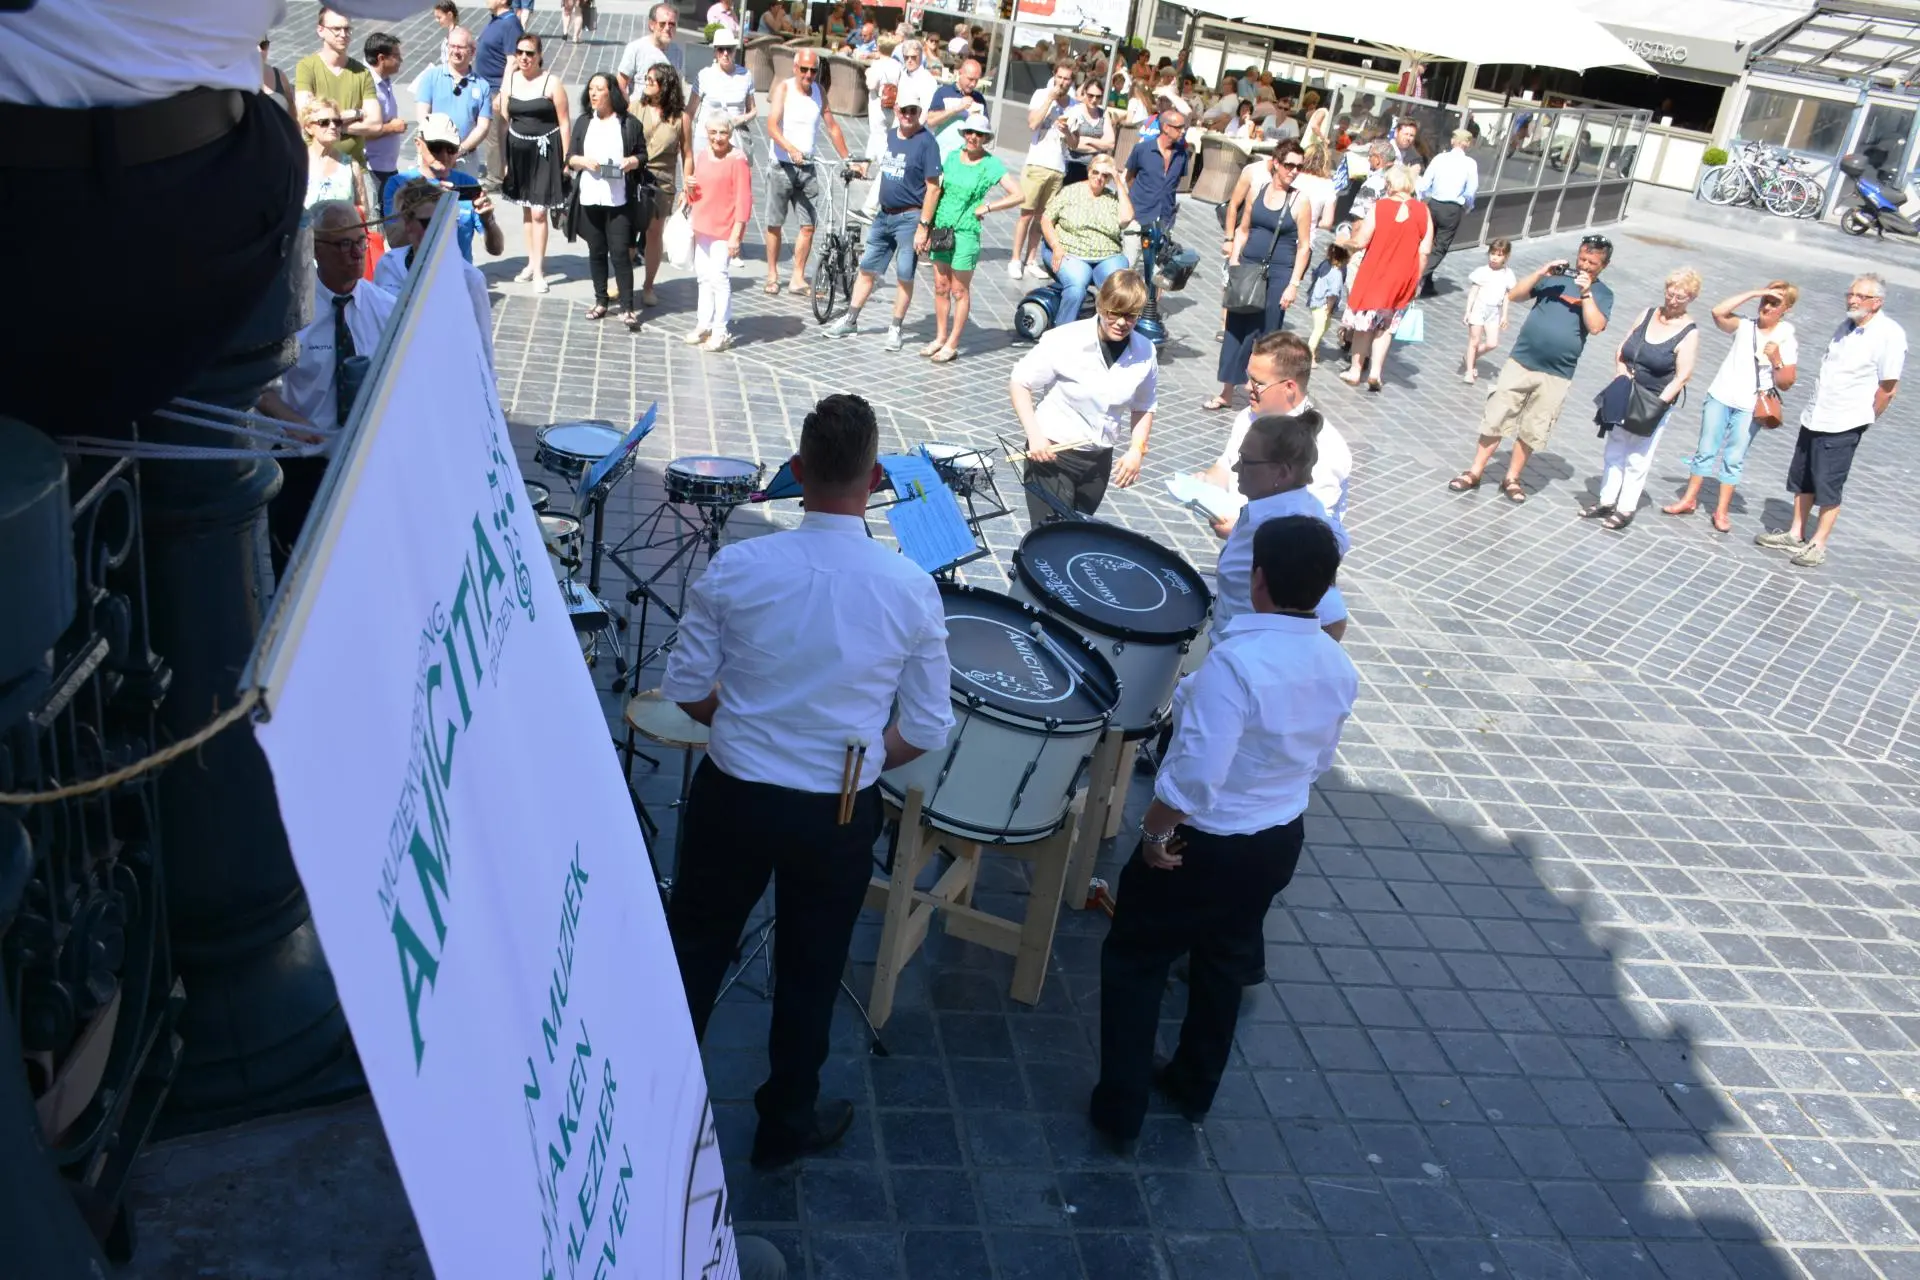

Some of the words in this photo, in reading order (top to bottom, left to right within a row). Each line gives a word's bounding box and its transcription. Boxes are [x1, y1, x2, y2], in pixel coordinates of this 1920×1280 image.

[1625, 38, 1688, 61] BISTRO
[1034, 558, 1081, 608] majestic
[1080, 561, 1121, 604] AMICITIA
[1004, 629, 1054, 692] AMICITIA
[391, 510, 505, 1078] AMICITIA
[541, 840, 589, 1064] MUZIEK
